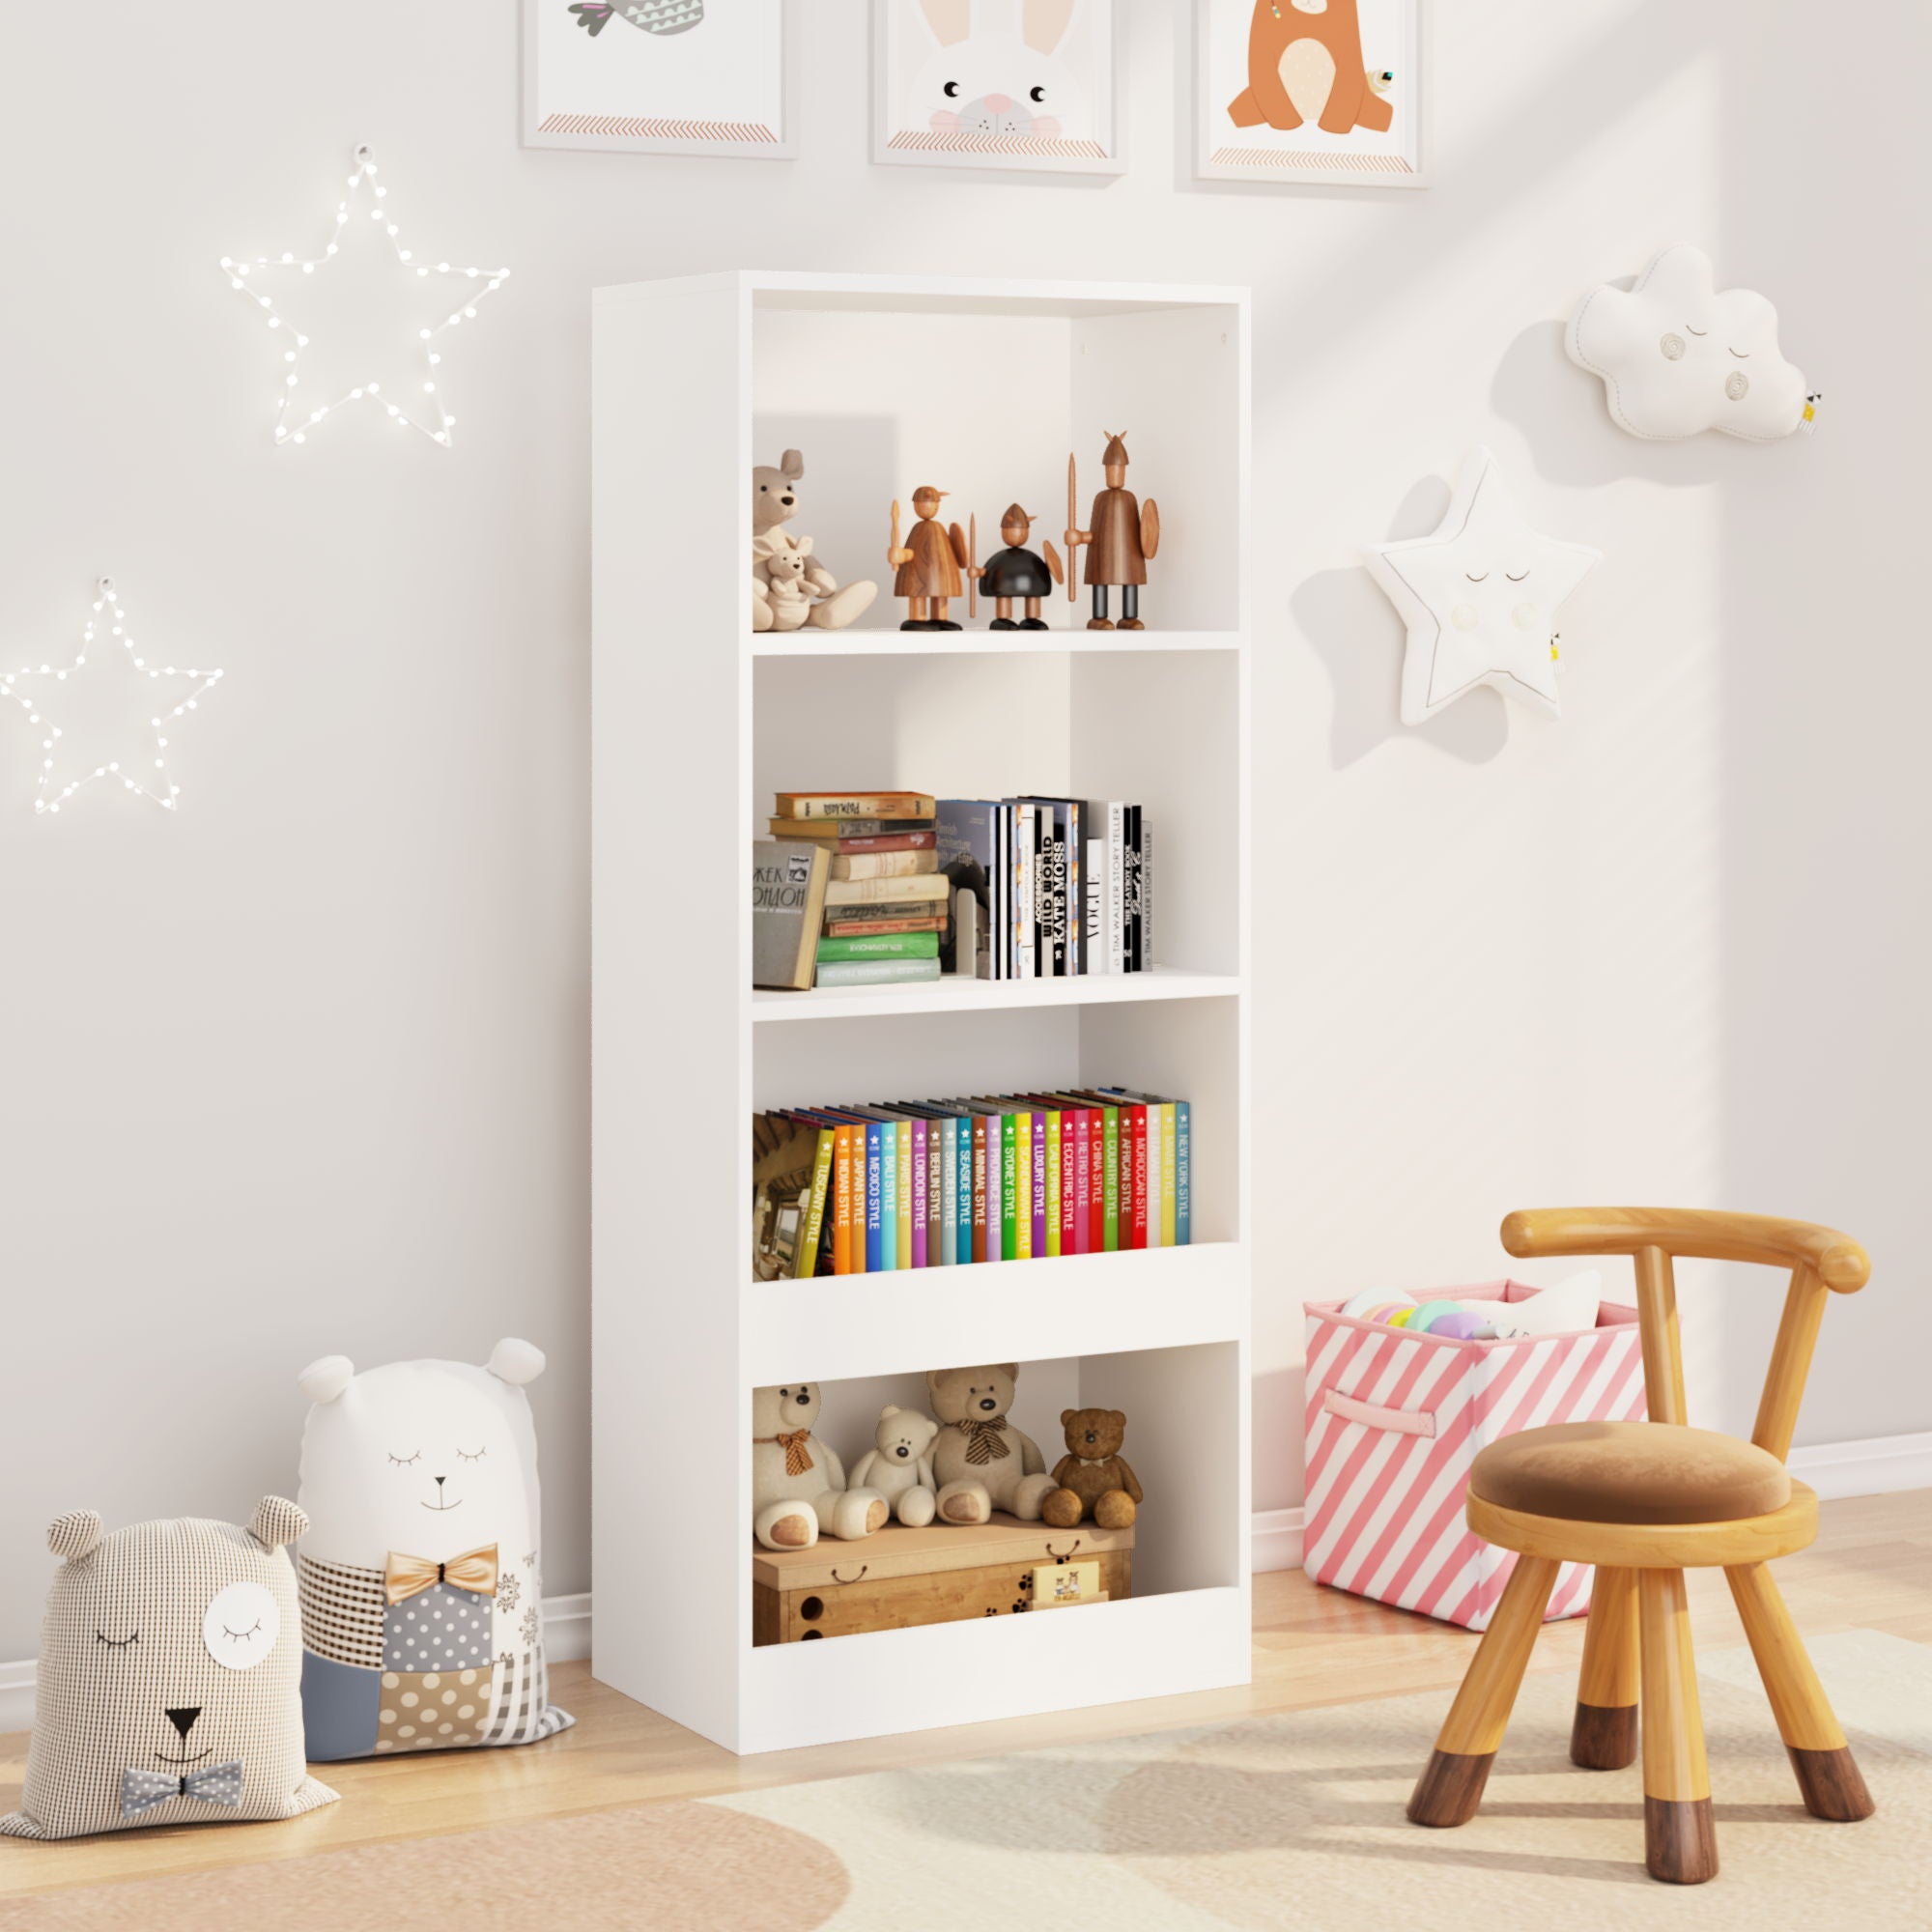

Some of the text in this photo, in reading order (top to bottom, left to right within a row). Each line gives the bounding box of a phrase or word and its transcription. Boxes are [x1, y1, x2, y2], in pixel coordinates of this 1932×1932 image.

[753, 867, 783, 883] ЖЕК
[1043, 837, 1052, 937] WILD WORLD
[753, 887, 806, 908] ОНДОН
[1053, 841, 1065, 944] KATE MOSS
[1087, 872, 1100, 939] VOGUE
[1078, 1142, 1089, 1176] RETRO
[1093, 1141, 1103, 1171] CHINA
[1121, 1138, 1131, 1181] AFRICAN
[1178, 1134, 1188, 1157] NEW
[838, 1159, 848, 1196] INDIAN
[854, 1158, 864, 1193] JAPAN
[868, 1157, 879, 1198] MEXICO
[899, 1154, 910, 1184] PARIS
[915, 1153, 925, 1197] LONDON
[929, 1152, 941, 1188] BERLIN
[945, 1151, 954, 1194] SWEDEN
[959, 1151, 971, 1192] SEASIDE
[975, 1149, 985, 1192] MINIMAL
[989, 1148, 1001, 1202] PROVENCE
[1005, 1147, 1014, 1186] SYDNEY
[1034, 1144, 1044, 1184] LUXURY
[1049, 1144, 1059, 1203] CALIFORNIA
[1064, 1142, 1074, 1199] ECCENTRIC
[1107, 1140, 1118, 1186] COUNTRY
[1135, 1138, 1146, 1195] MOROCCAN
[1178, 1159, 1188, 1187] YORK
[811, 1164, 831, 1209] TUSCANY
[884, 1182, 895, 1212] STYLE
[1020, 1146, 1030, 1219] SCANDINAVIAN
[1078, 1178, 1089, 1208] STYLE
[1093, 1173, 1103, 1204] STYLE
[1121, 1183, 1131, 1214] STYLE
[1150, 1175, 1160, 1207] STYLE
[838, 1199, 848, 1227] STYLE
[854, 1195, 864, 1225] STYLE
[868, 1200, 879, 1230] STYLE
[899, 1187, 910, 1217] STYLE
[915, 1199, 925, 1231] STYLE
[929, 1190, 941, 1222] STYLE
[945, 1197, 954, 1228] STYLE
[959, 1194, 971, 1226] STYLE
[975, 1195, 985, 1226] STYLE
[1005, 1188, 1014, 1219] STYLE
[1034, 1186, 1044, 1217] STYLE
[1064, 1201, 1074, 1232] STYLE
[1107, 1188, 1118, 1220] STYLE
[1135, 1197, 1146, 1228] STYLE
[1178, 1188, 1188, 1219] STYLE
[806, 1211, 820, 1243] STYLE
[989, 1204, 1001, 1236] STYLE
[1049, 1205, 1059, 1236] STYLE
[1020, 1222, 1030, 1252] STYLE
